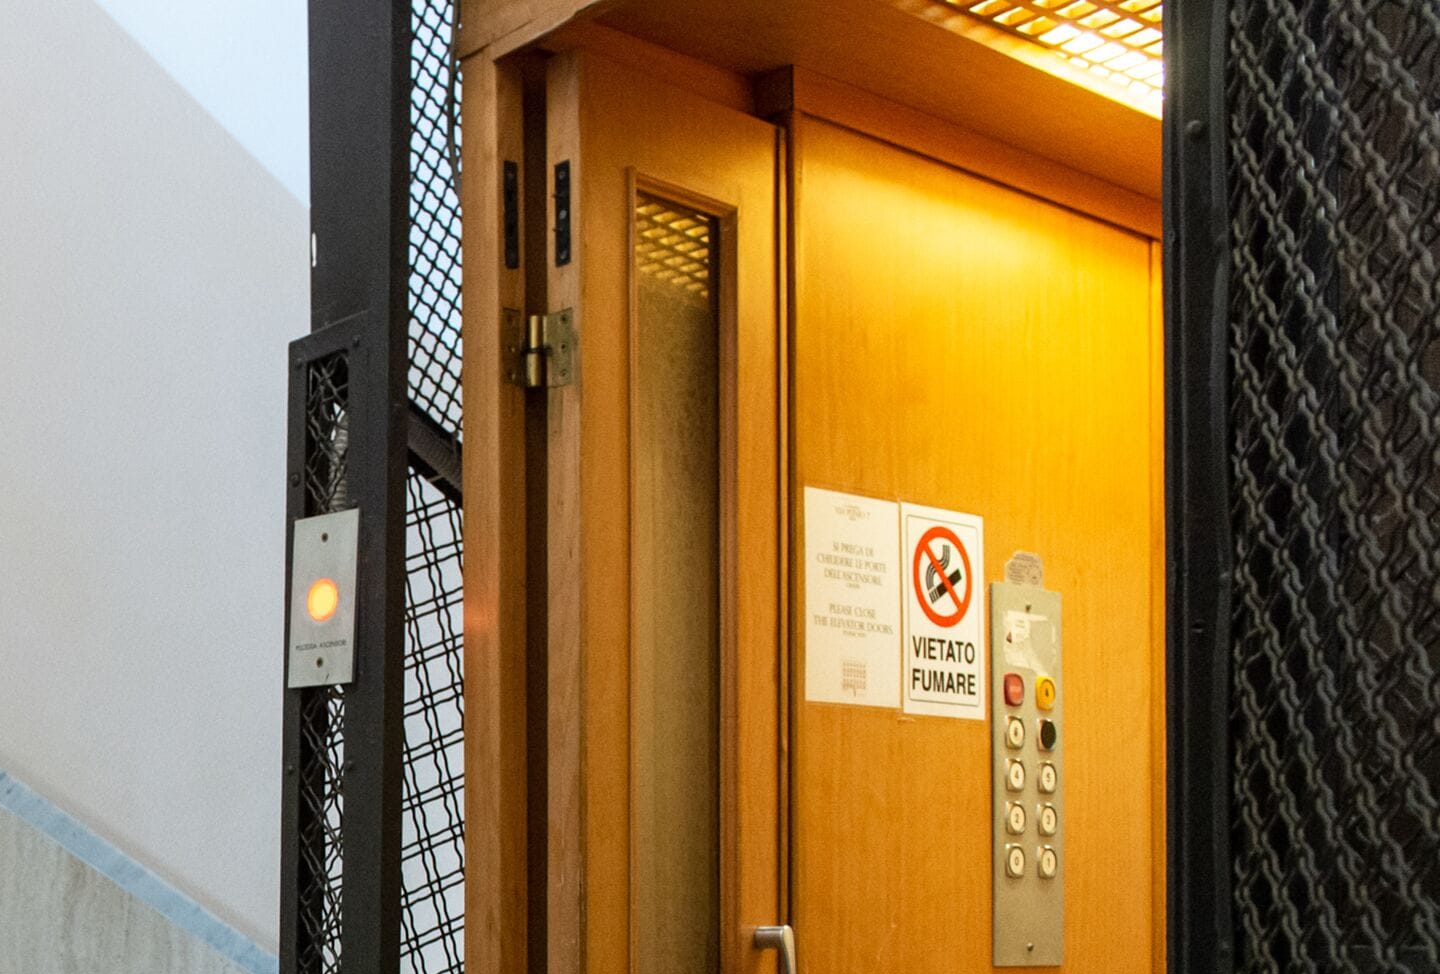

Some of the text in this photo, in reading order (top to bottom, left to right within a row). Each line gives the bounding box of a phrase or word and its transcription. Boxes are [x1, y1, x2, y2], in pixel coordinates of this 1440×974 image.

[841, 543, 864, 556] PREGA
[816, 553, 886, 573] CHIUDERE LE PORTE
[829, 603, 876, 619] PLEASE CLOSE
[813, 614, 828, 627] THE
[830, 617, 865, 631] ELEVATOR
[867, 622, 894, 635] DOORS
[912, 635, 975, 664] VIETATO
[912, 668, 976, 696] FUMARE
